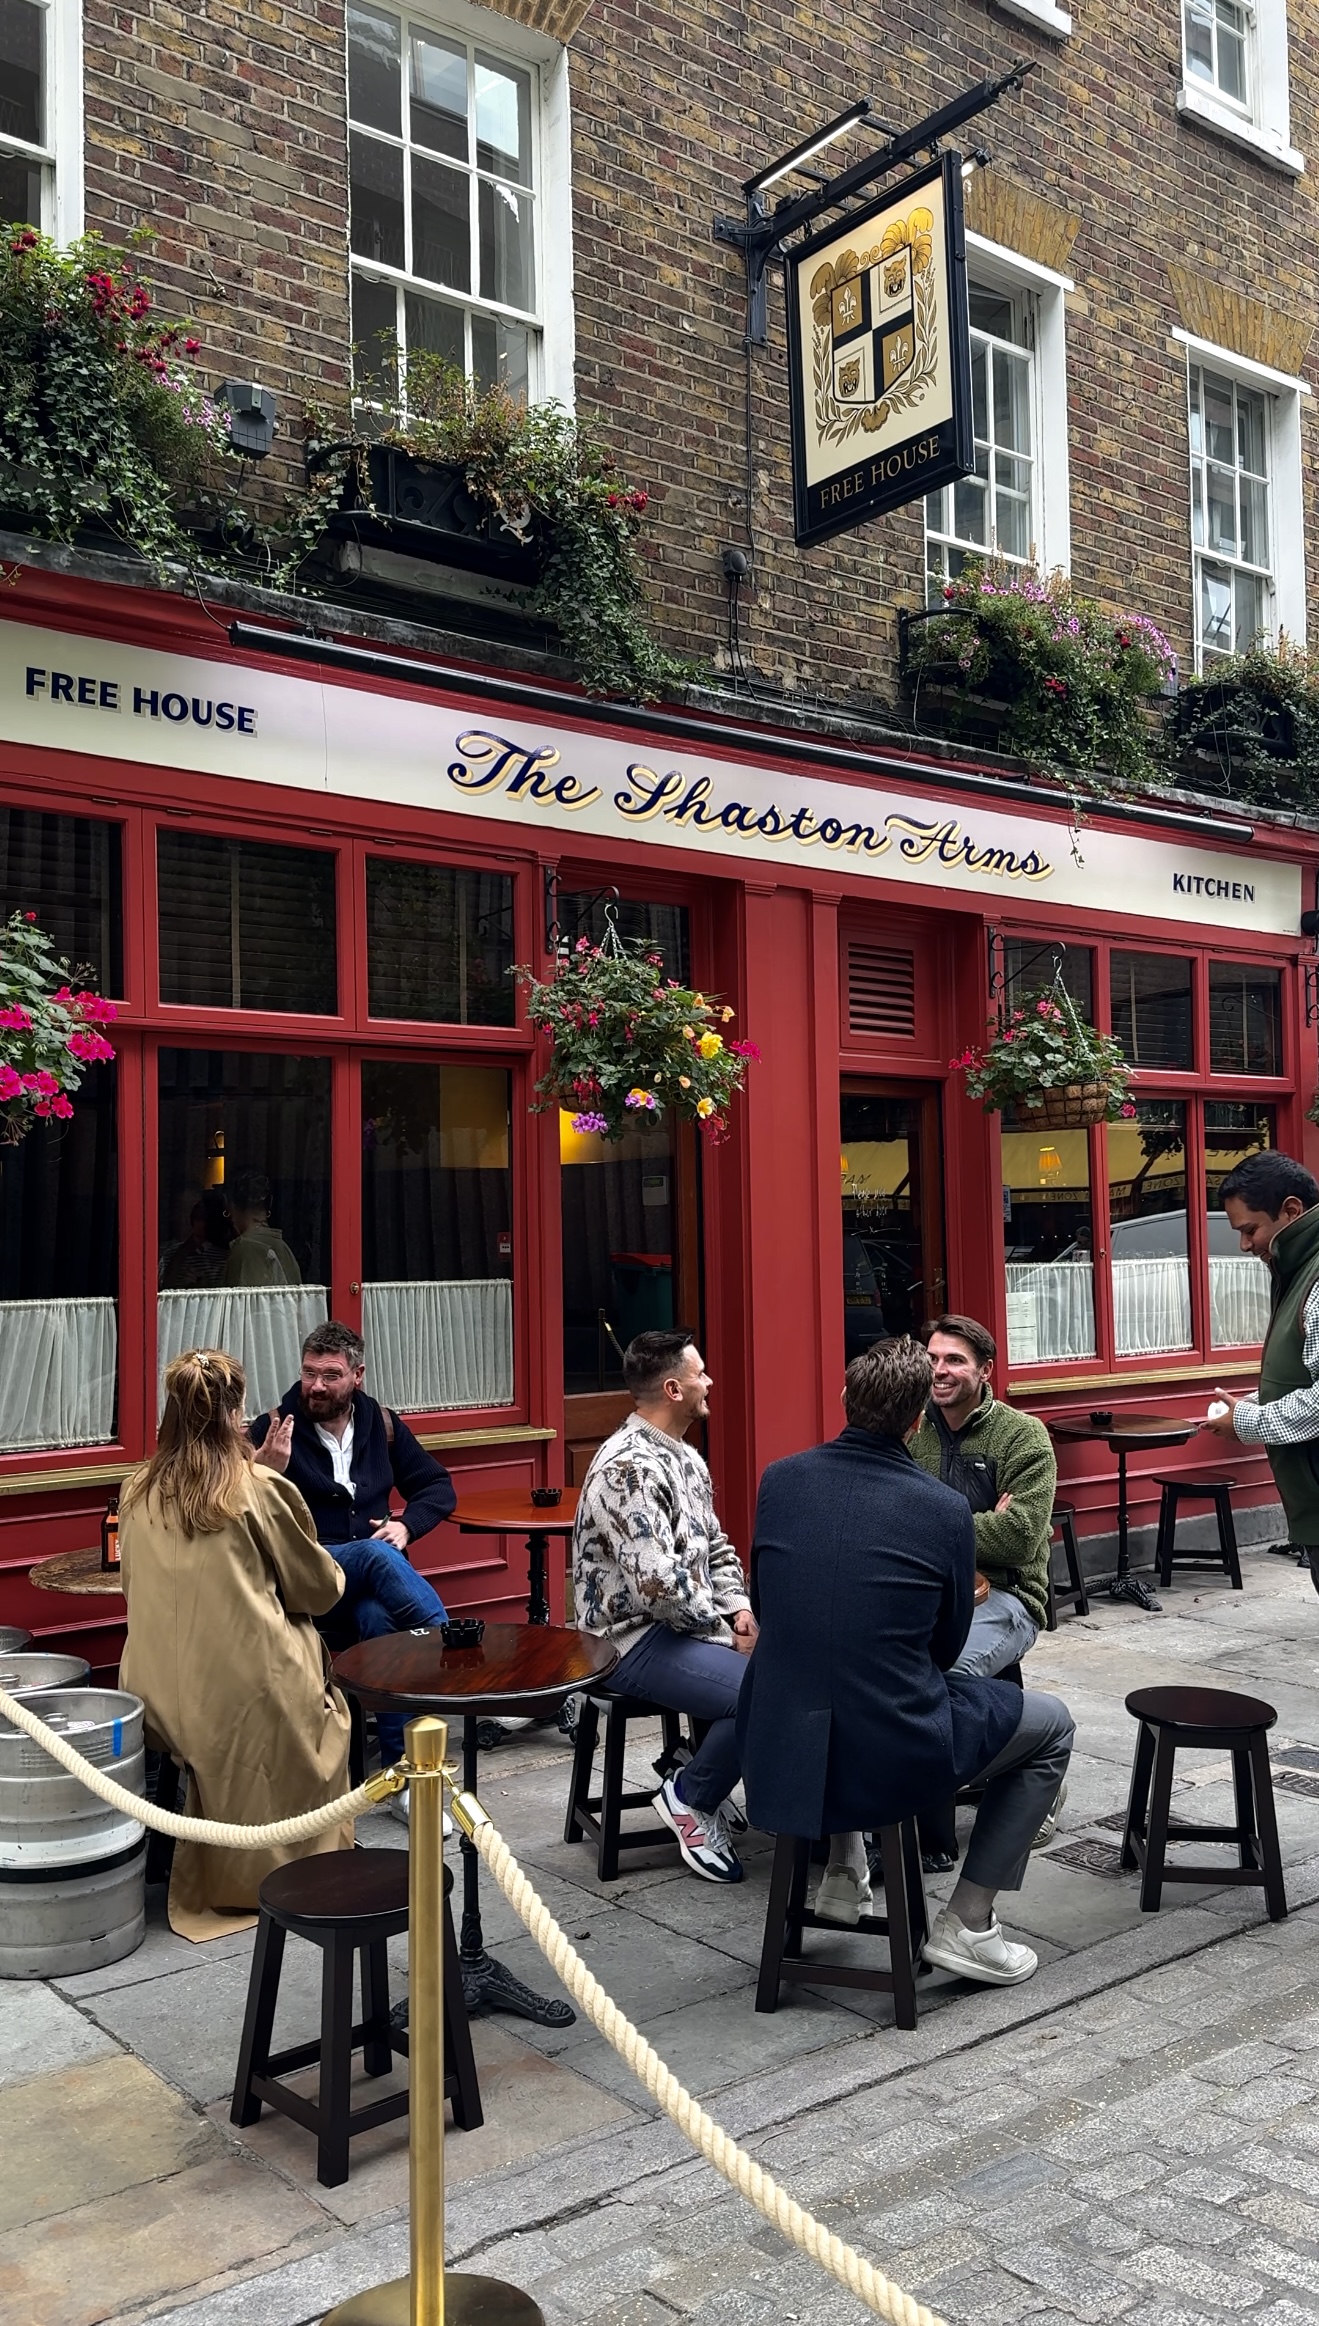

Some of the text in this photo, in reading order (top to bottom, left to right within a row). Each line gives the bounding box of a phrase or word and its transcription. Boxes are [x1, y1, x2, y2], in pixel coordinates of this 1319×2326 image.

[820, 435, 941, 510] FREE HOUSE
[26, 666, 257, 737] FREE HOUSE
[446, 729, 1055, 882] The Shaston Arms
[1173, 873, 1255, 904] KITCHEN
